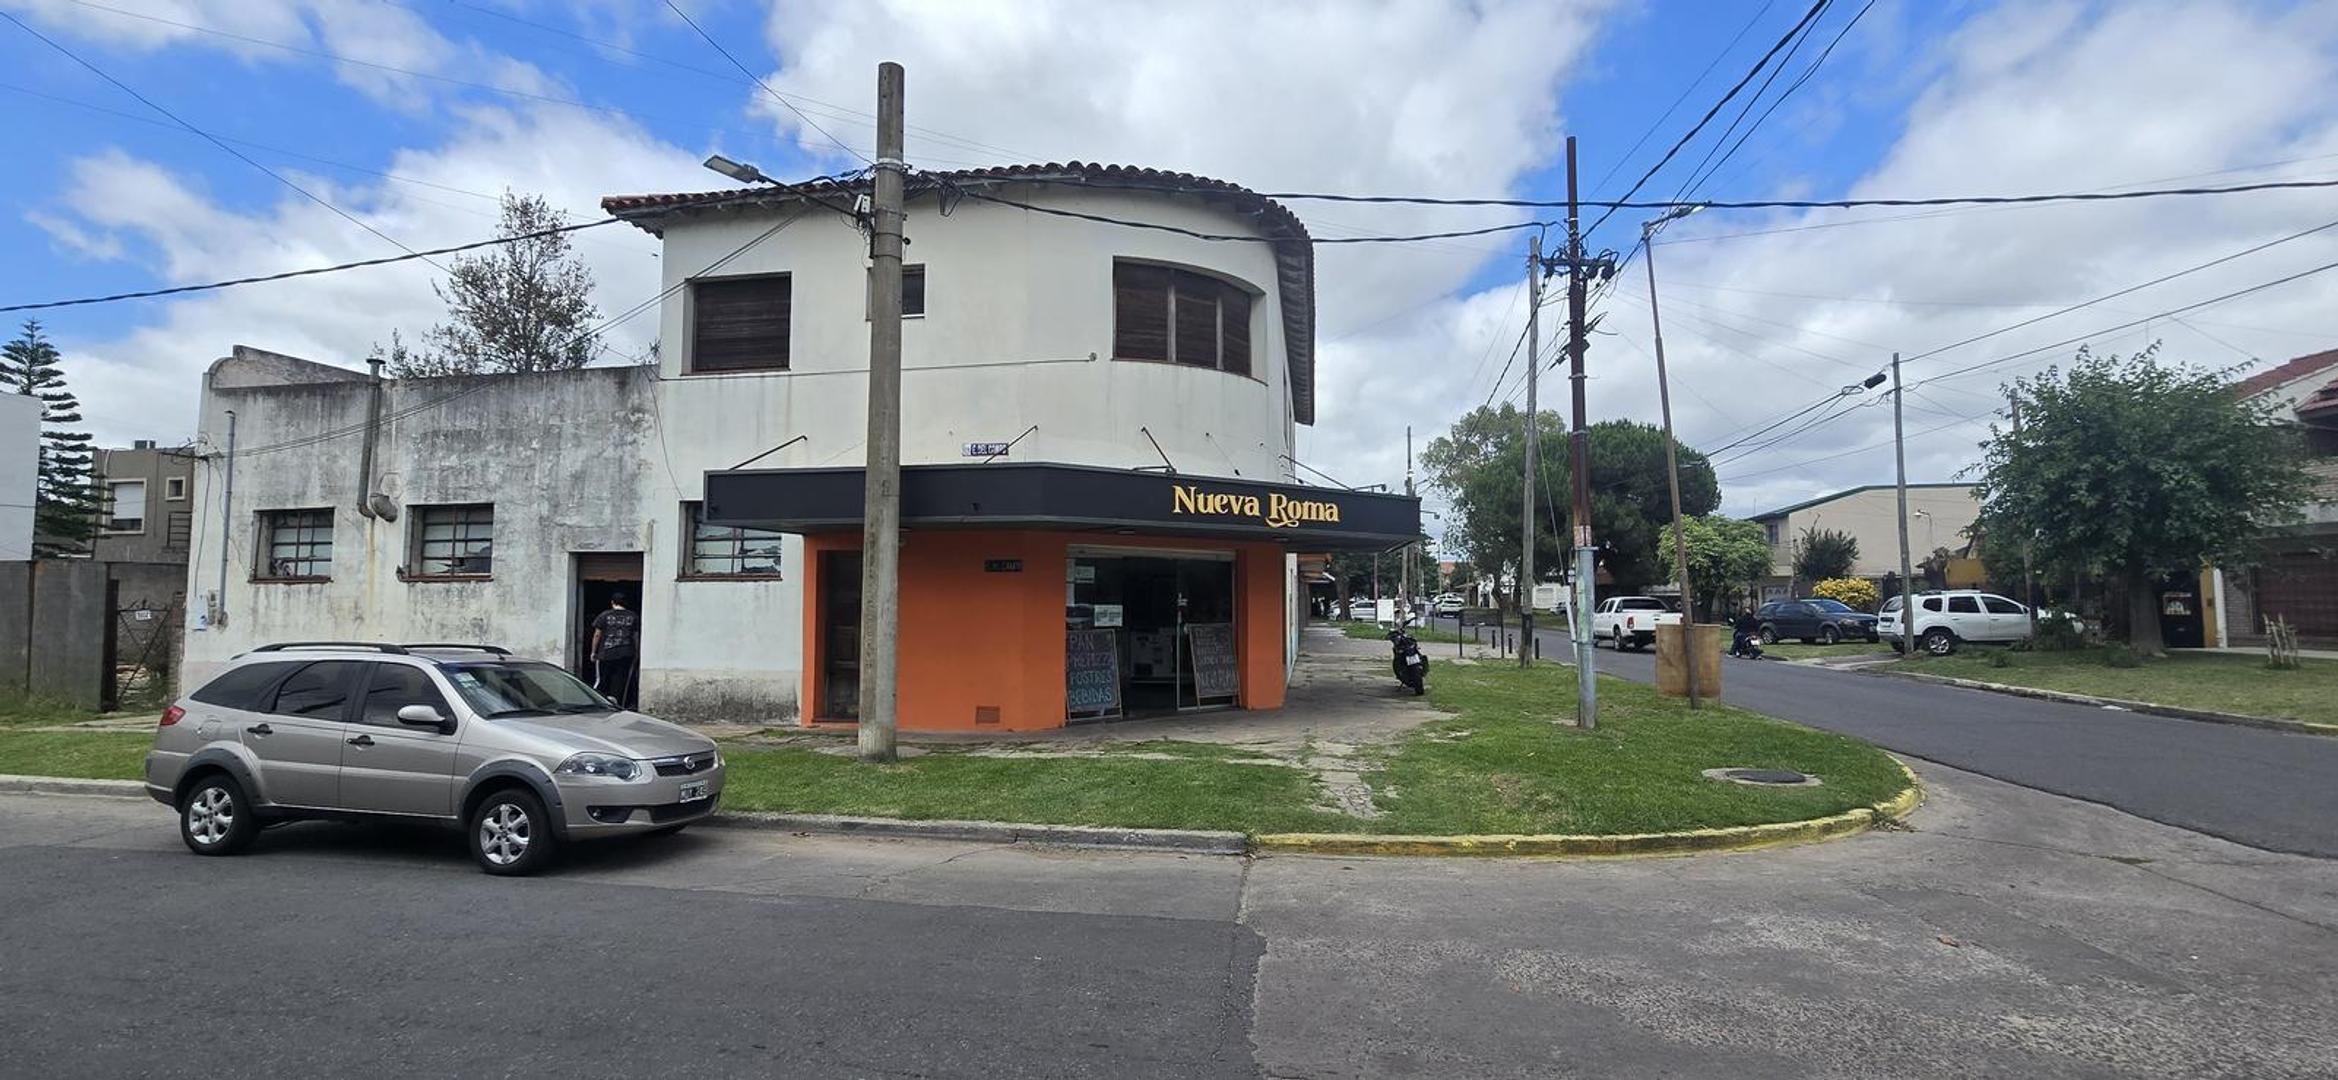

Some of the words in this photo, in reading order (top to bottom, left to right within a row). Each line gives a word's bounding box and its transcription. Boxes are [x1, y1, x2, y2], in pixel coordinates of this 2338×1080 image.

[1172, 485, 1260, 516] Nueva
[1265, 493, 1339, 528] Roma
[1070, 631, 1095, 649] PAN
[1070, 670, 1112, 685] POSTRES
[1070, 687, 1112, 704] BEBIDAS
